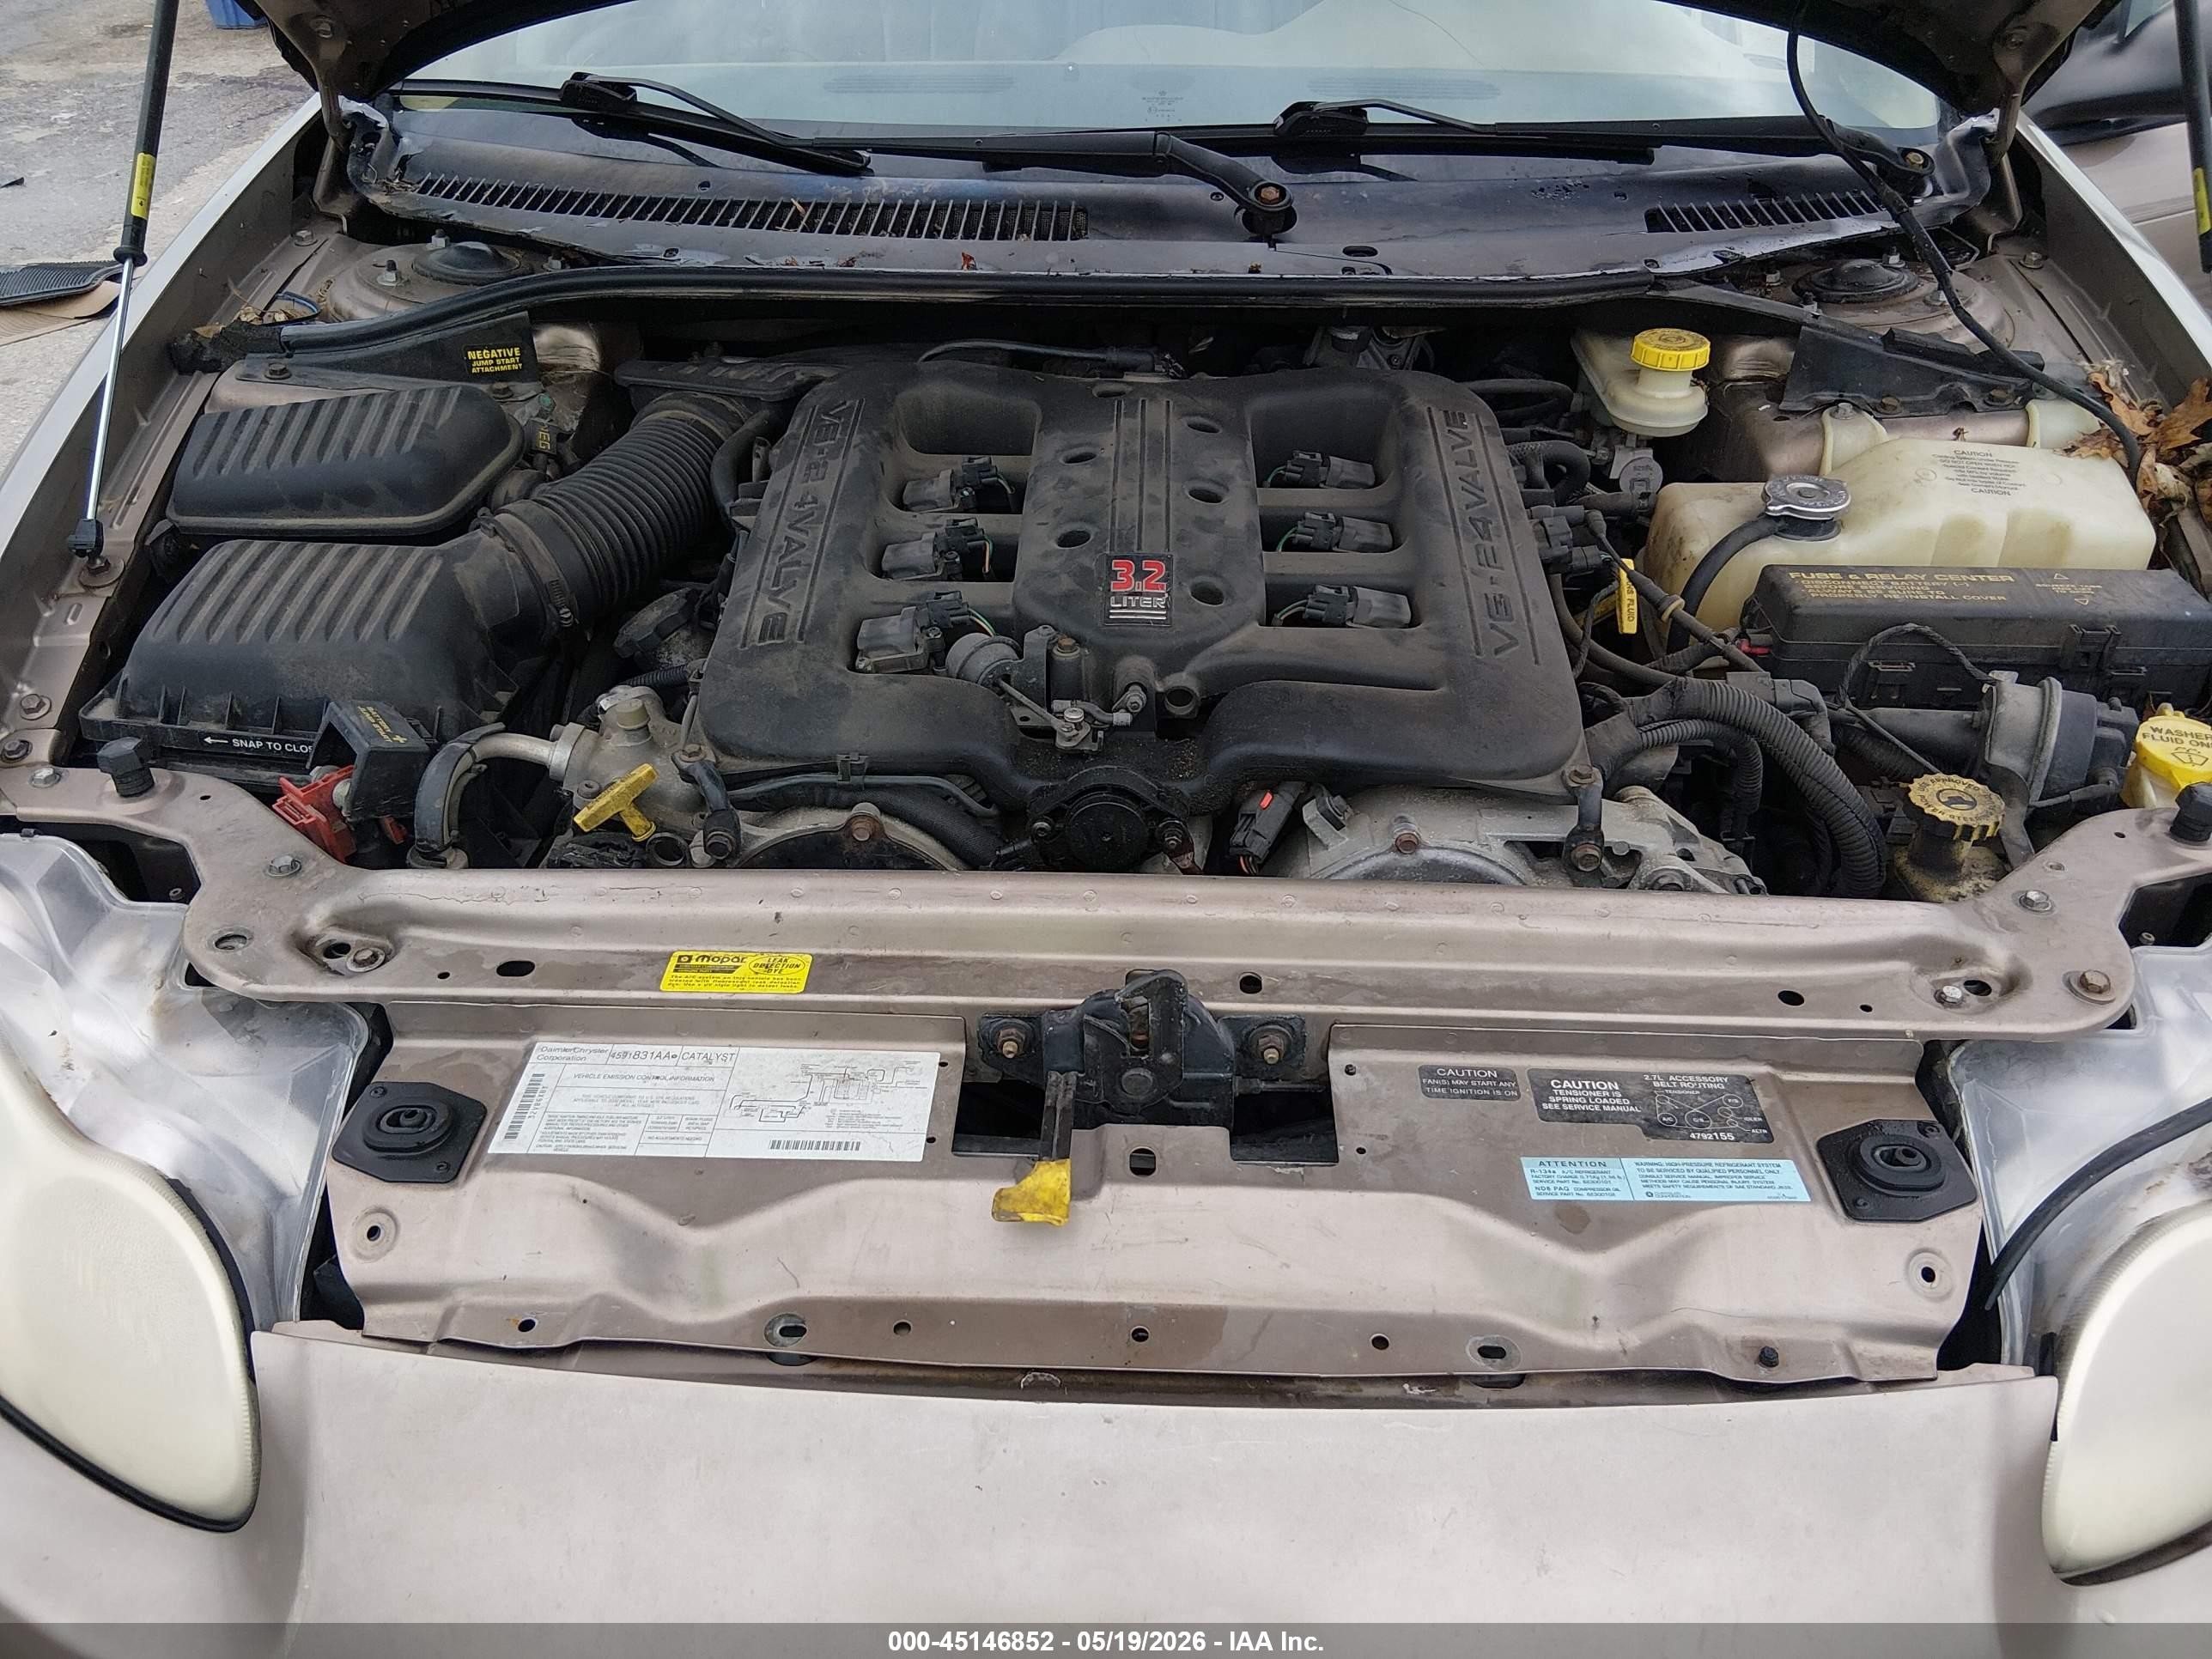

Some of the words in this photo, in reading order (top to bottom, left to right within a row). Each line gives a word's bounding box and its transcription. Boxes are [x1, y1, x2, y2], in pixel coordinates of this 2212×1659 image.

[467, 347, 520, 360] NEGATIVE
[471, 363, 522, 373] ATTACHMENT
[1443, 410, 1487, 510] VALVE
[1971, 488, 2011, 496] CAUTION
[1110, 559, 1167, 592] 3.2
[1934, 574, 2014, 582] CENTER
[1110, 596, 1166, 608] LITER
[1626, 598, 1636, 623] FLUID
[2142, 732, 2185, 744] FLUID
[232, 738, 263, 749] SNAP
[266, 742, 282, 750] TO
[540, 1046, 609, 1054] DaimlerChrysler
[681, 1051, 736, 1061] CATALYST
[1436, 1068, 1498, 1079] CAUTION
[1551, 1079, 1620, 1091] CAUTION
[1553, 1089, 1610, 1097] TENSIONER
[1602, 1104, 1642, 1113] MANUAL
[1690, 1132, 1735, 1140] 4792155
